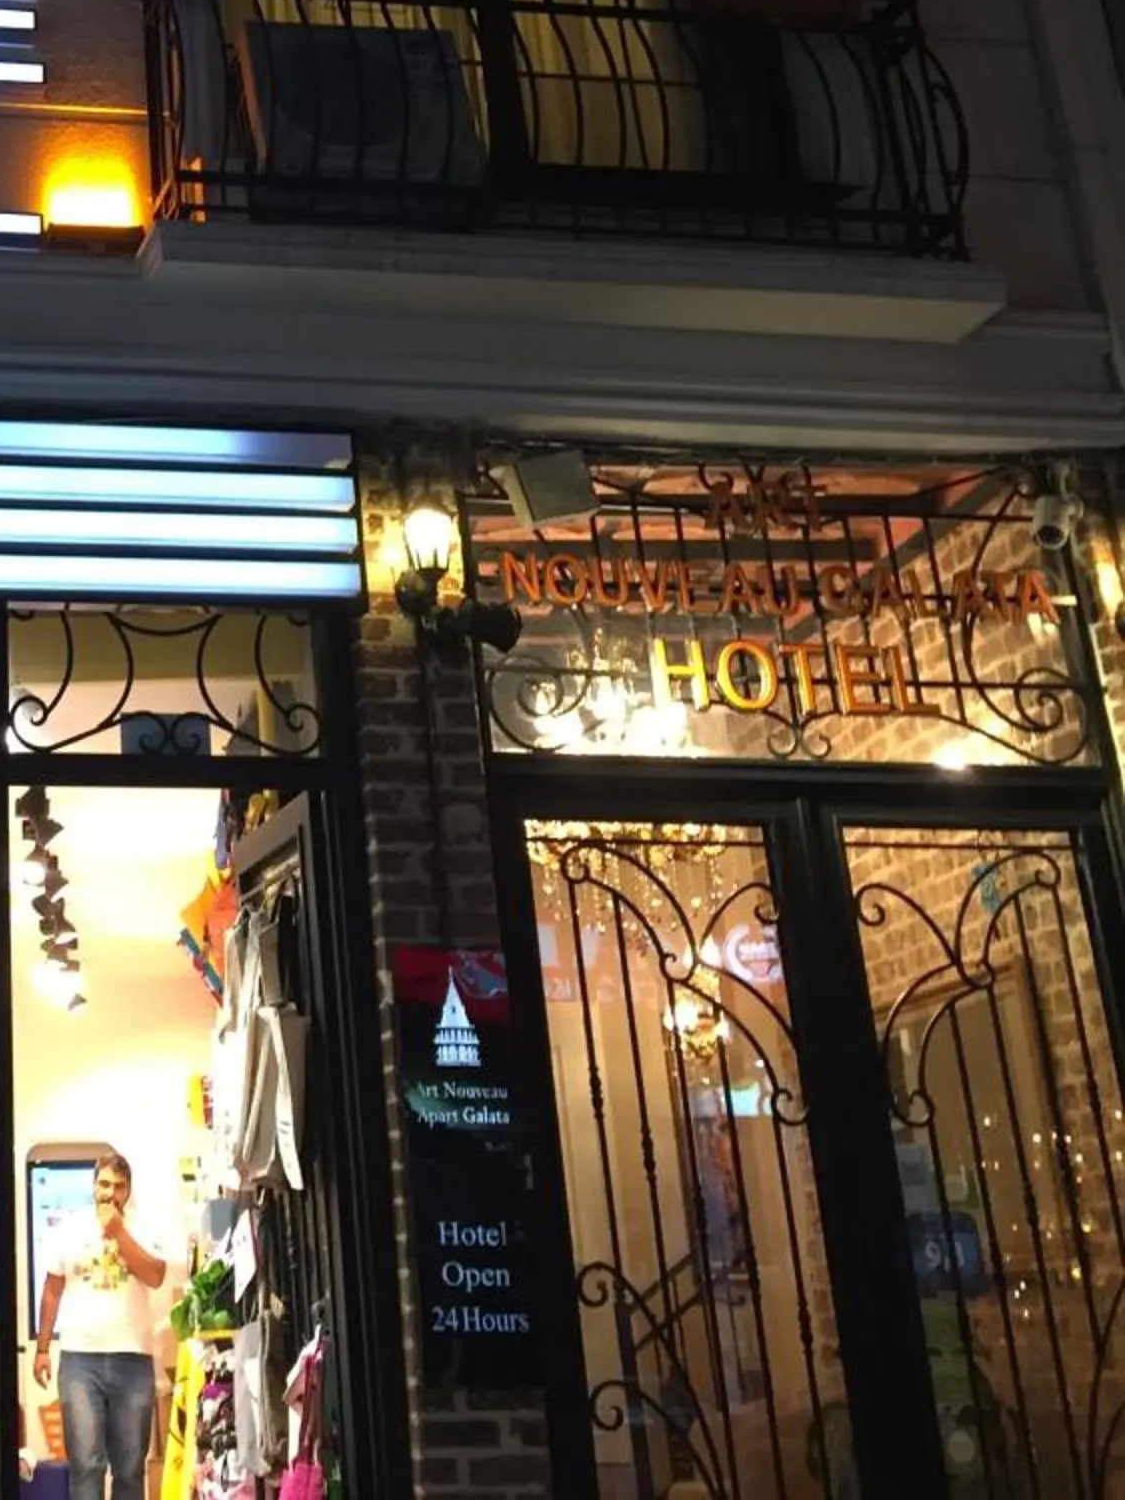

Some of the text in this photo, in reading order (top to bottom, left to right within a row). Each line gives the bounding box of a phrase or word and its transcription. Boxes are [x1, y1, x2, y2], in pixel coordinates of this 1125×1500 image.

[650, 636, 941, 718] HOTEL
[416, 1081, 508, 1100] Art Nouveau
[417, 1105, 510, 1130] Apart Galata
[438, 1220, 507, 1247] Hotel
[441, 1261, 511, 1293] Open
